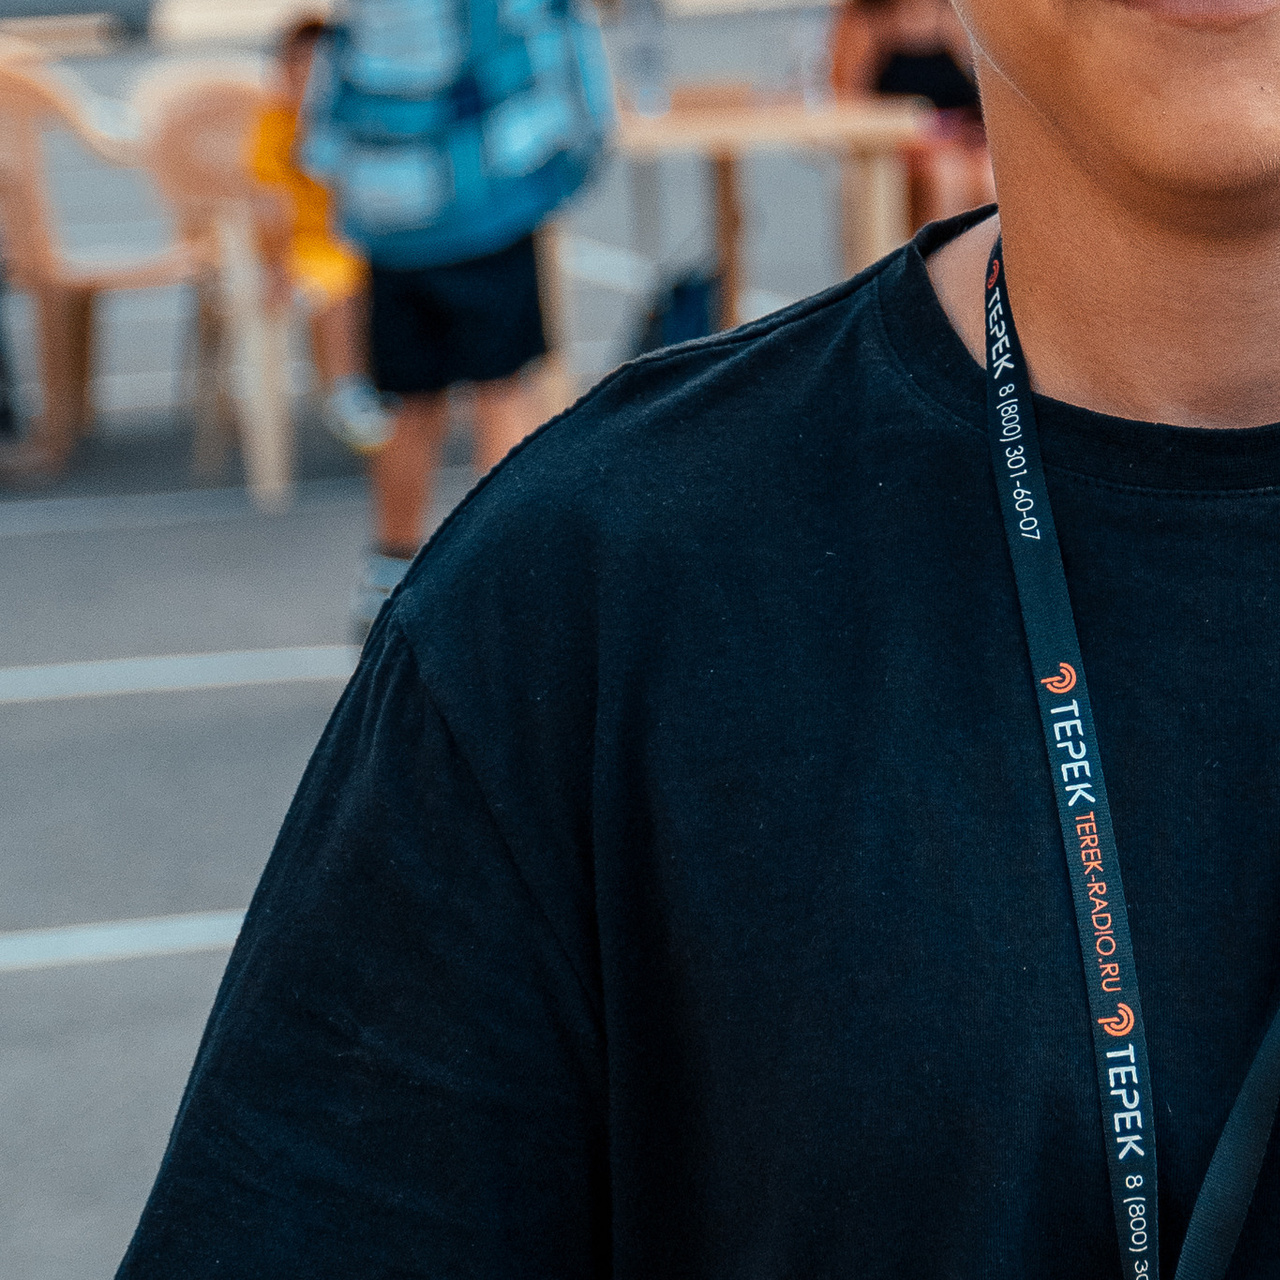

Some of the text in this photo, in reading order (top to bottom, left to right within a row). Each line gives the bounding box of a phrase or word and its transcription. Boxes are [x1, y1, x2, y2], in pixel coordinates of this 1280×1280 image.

[988, 287, 1041, 540] ТЕРЕК 8 (800) 301-60-07
[1050, 698, 1122, 993] ТЕРЕК TEREK-RADIO.RU
[1105, 1043, 1145, 1160] ТЕРЕК
[1122, 1196, 1148, 1253] (800)
[1125, 1174, 1144, 1189] 8
